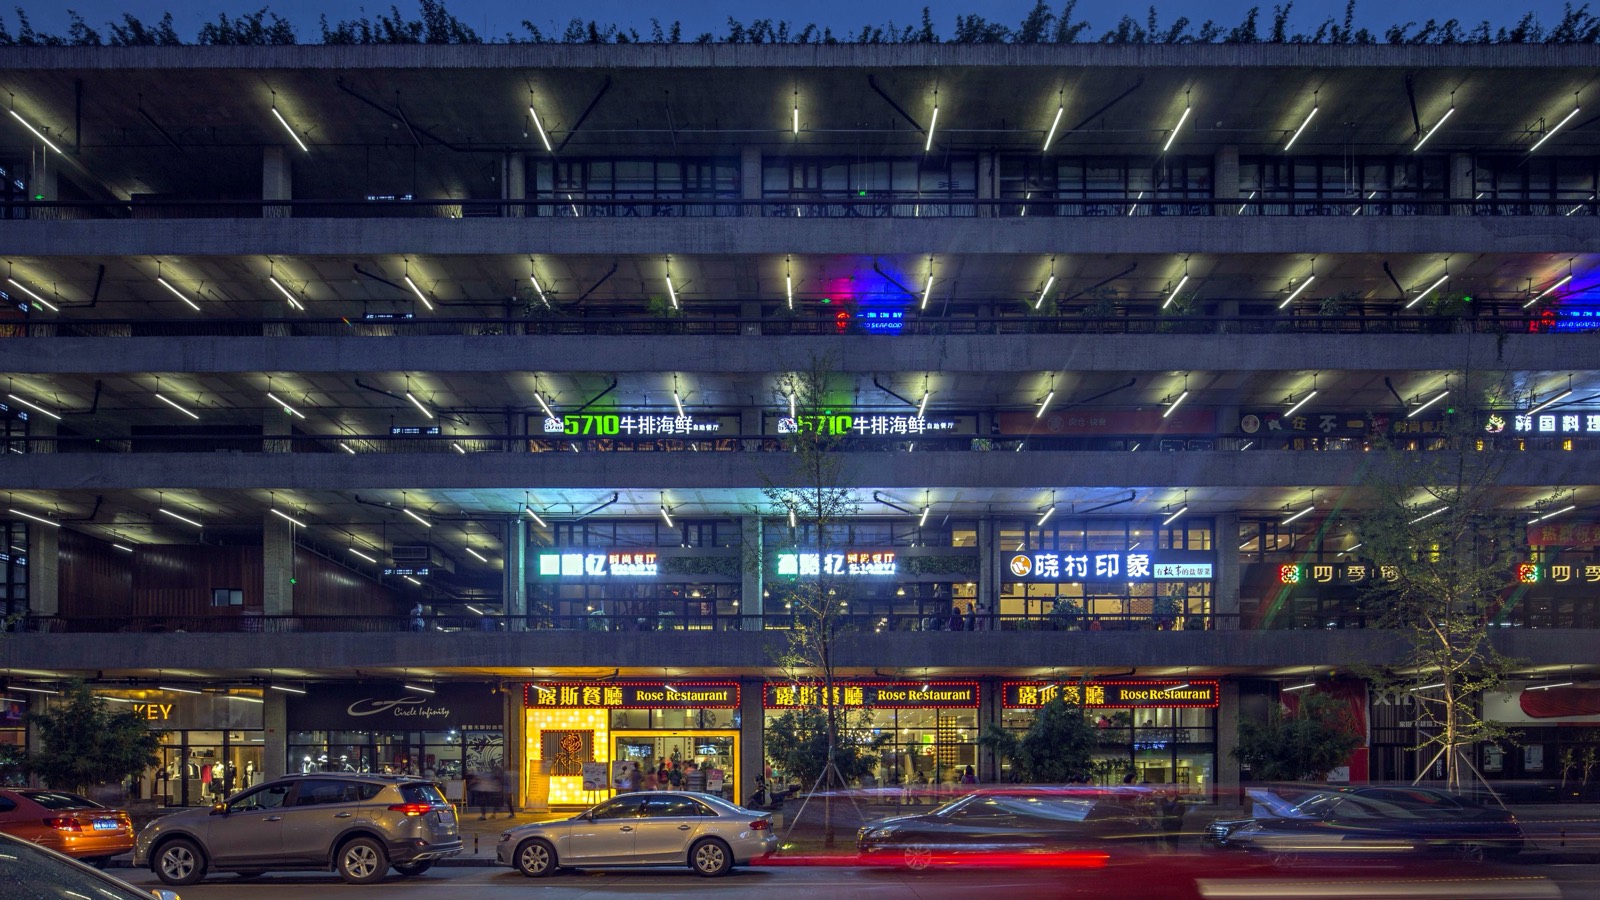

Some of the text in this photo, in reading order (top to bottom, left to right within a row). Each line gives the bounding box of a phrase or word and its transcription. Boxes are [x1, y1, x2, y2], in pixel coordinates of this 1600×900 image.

[564, 415, 619, 435] 5710
[620, 415, 693, 435] 牛排海鲜
[797, 415, 852, 436] 5710
[853, 415, 926, 435] 牛排海鲜
[1515, 414, 1600, 432] 韩国料理
[1034, 553, 1151, 577] 晓村印象
[537, 686, 728, 706] 露斯餐廳 Rose Restaurant
[877, 690, 906, 701] Rose
[908, 689, 971, 701] Restaurant
[1120, 689, 1148, 700] Rose
[1150, 689, 1211, 700] Restaurant
[133, 704, 173, 720] KEY
[394, 706, 450, 719] Circle Infinity
